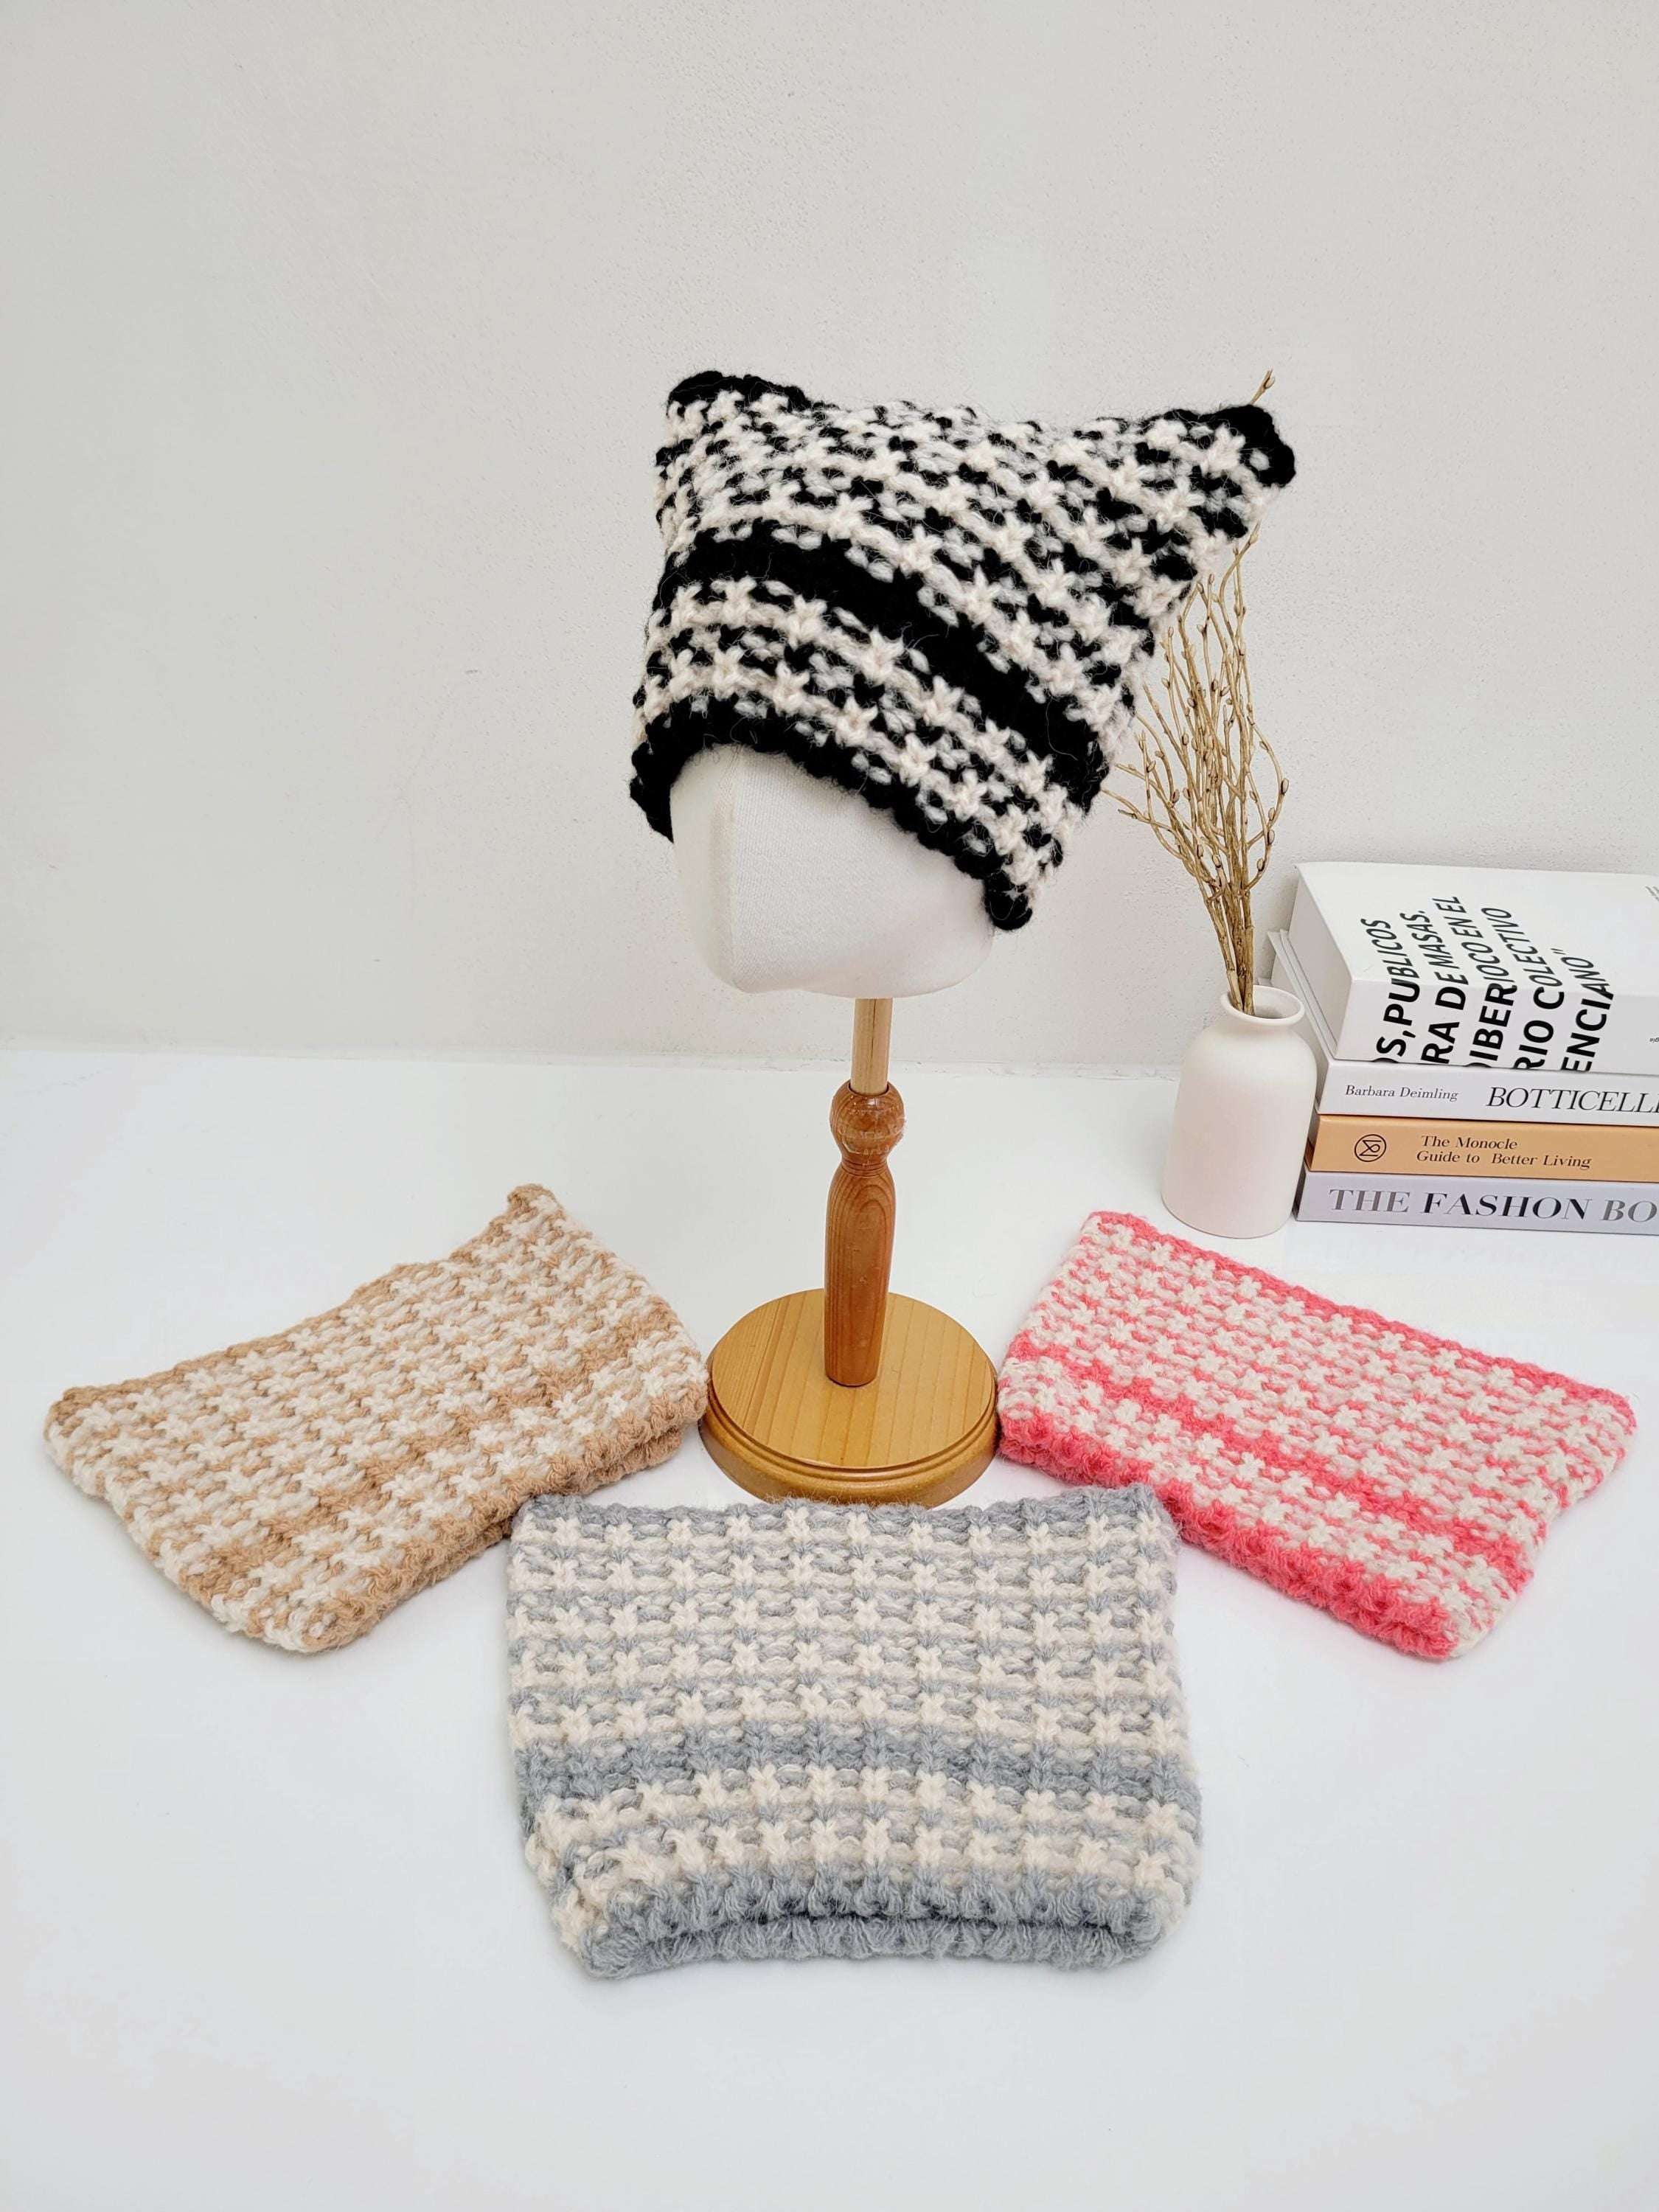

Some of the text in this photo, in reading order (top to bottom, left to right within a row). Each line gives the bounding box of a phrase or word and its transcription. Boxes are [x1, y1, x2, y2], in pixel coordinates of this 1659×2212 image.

[1399, 910, 1461, 971] MASAS.
[1481, 907, 1565, 1009] COLECTIVO
[1432, 896, 1517, 1068] IBERIOCO EN EL
[1434, 972, 1469, 1011] DE
[1345, 1085, 1458, 1102] Barbara Deimling
[1422, 1135, 1517, 1150] The Monocle
[1416, 1150, 1592, 1169] Guide to Better Living
[1329, 1189, 1411, 1213] THE
